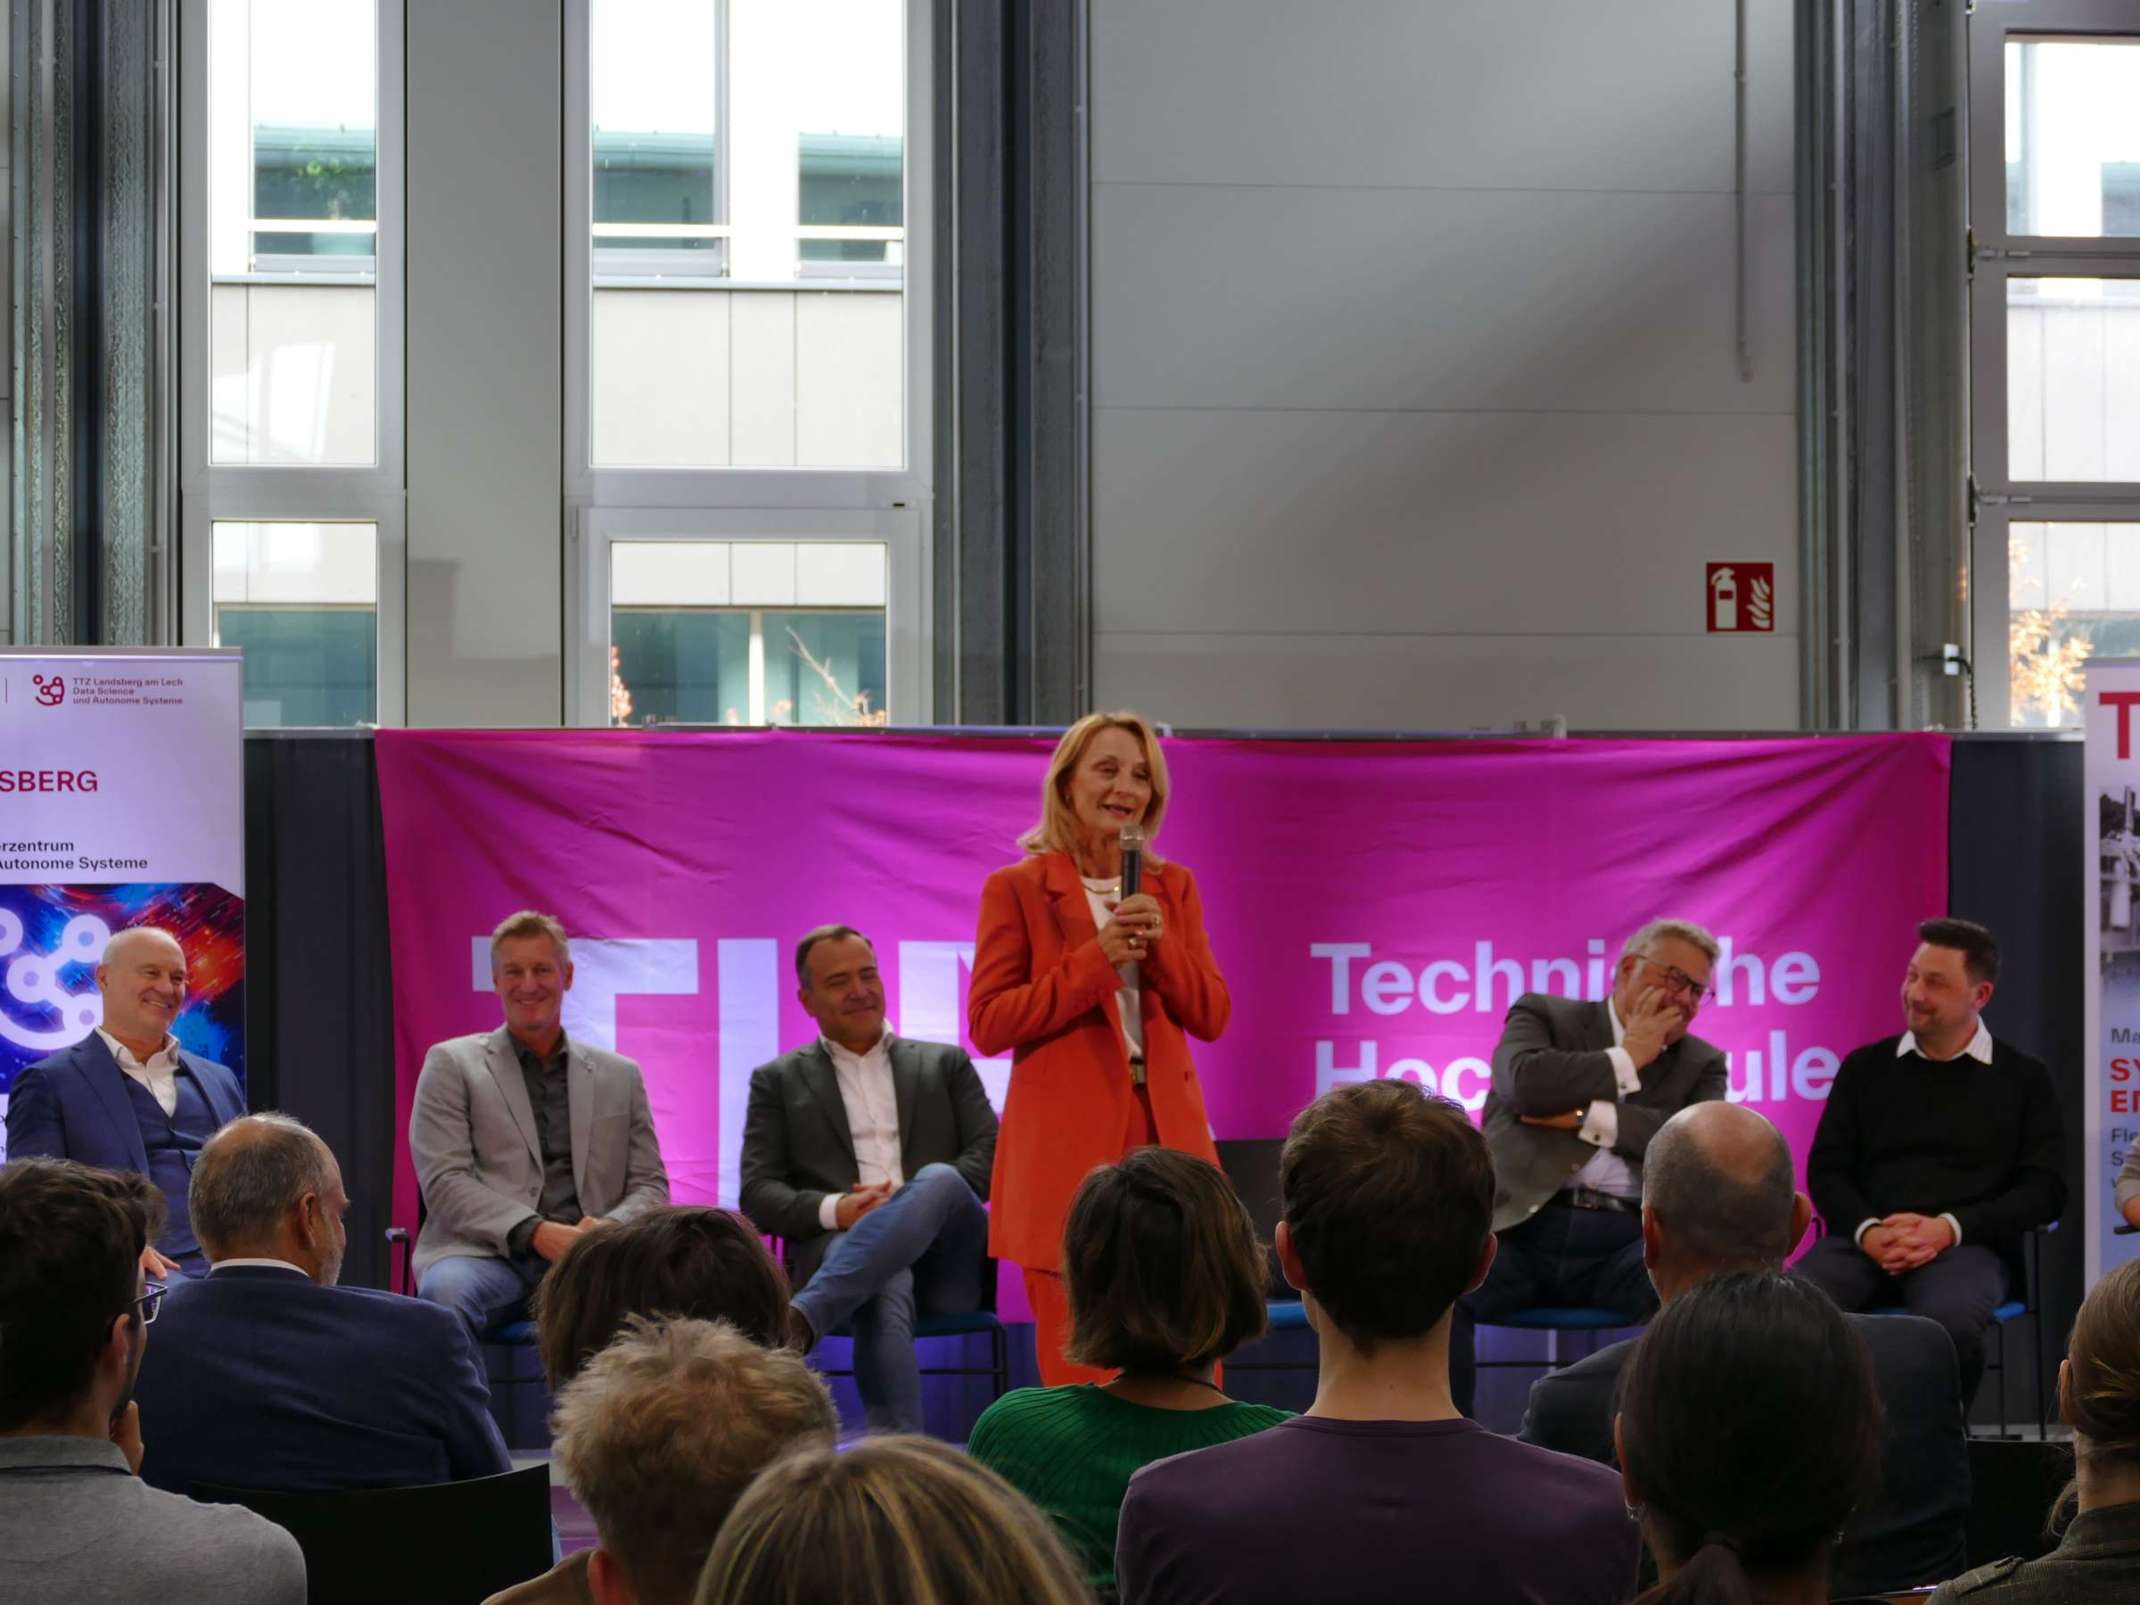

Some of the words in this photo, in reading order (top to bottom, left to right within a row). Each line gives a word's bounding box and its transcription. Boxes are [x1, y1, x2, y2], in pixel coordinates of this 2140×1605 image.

[73, 678, 91, 686] TTZ
[94, 678, 142, 687] Landsberg
[161, 678, 183, 686] Lech
[73, 687, 95, 695] Data
[97, 687, 134, 695] Science
[73, 696, 90, 705] und
[92, 696, 140, 705] Autonome
[143, 696, 183, 706] Systeme
[0, 840, 75, 852] rzentrum
[79, 857, 148, 872] Systeme
[1309, 936, 1821, 1015] Technihe
